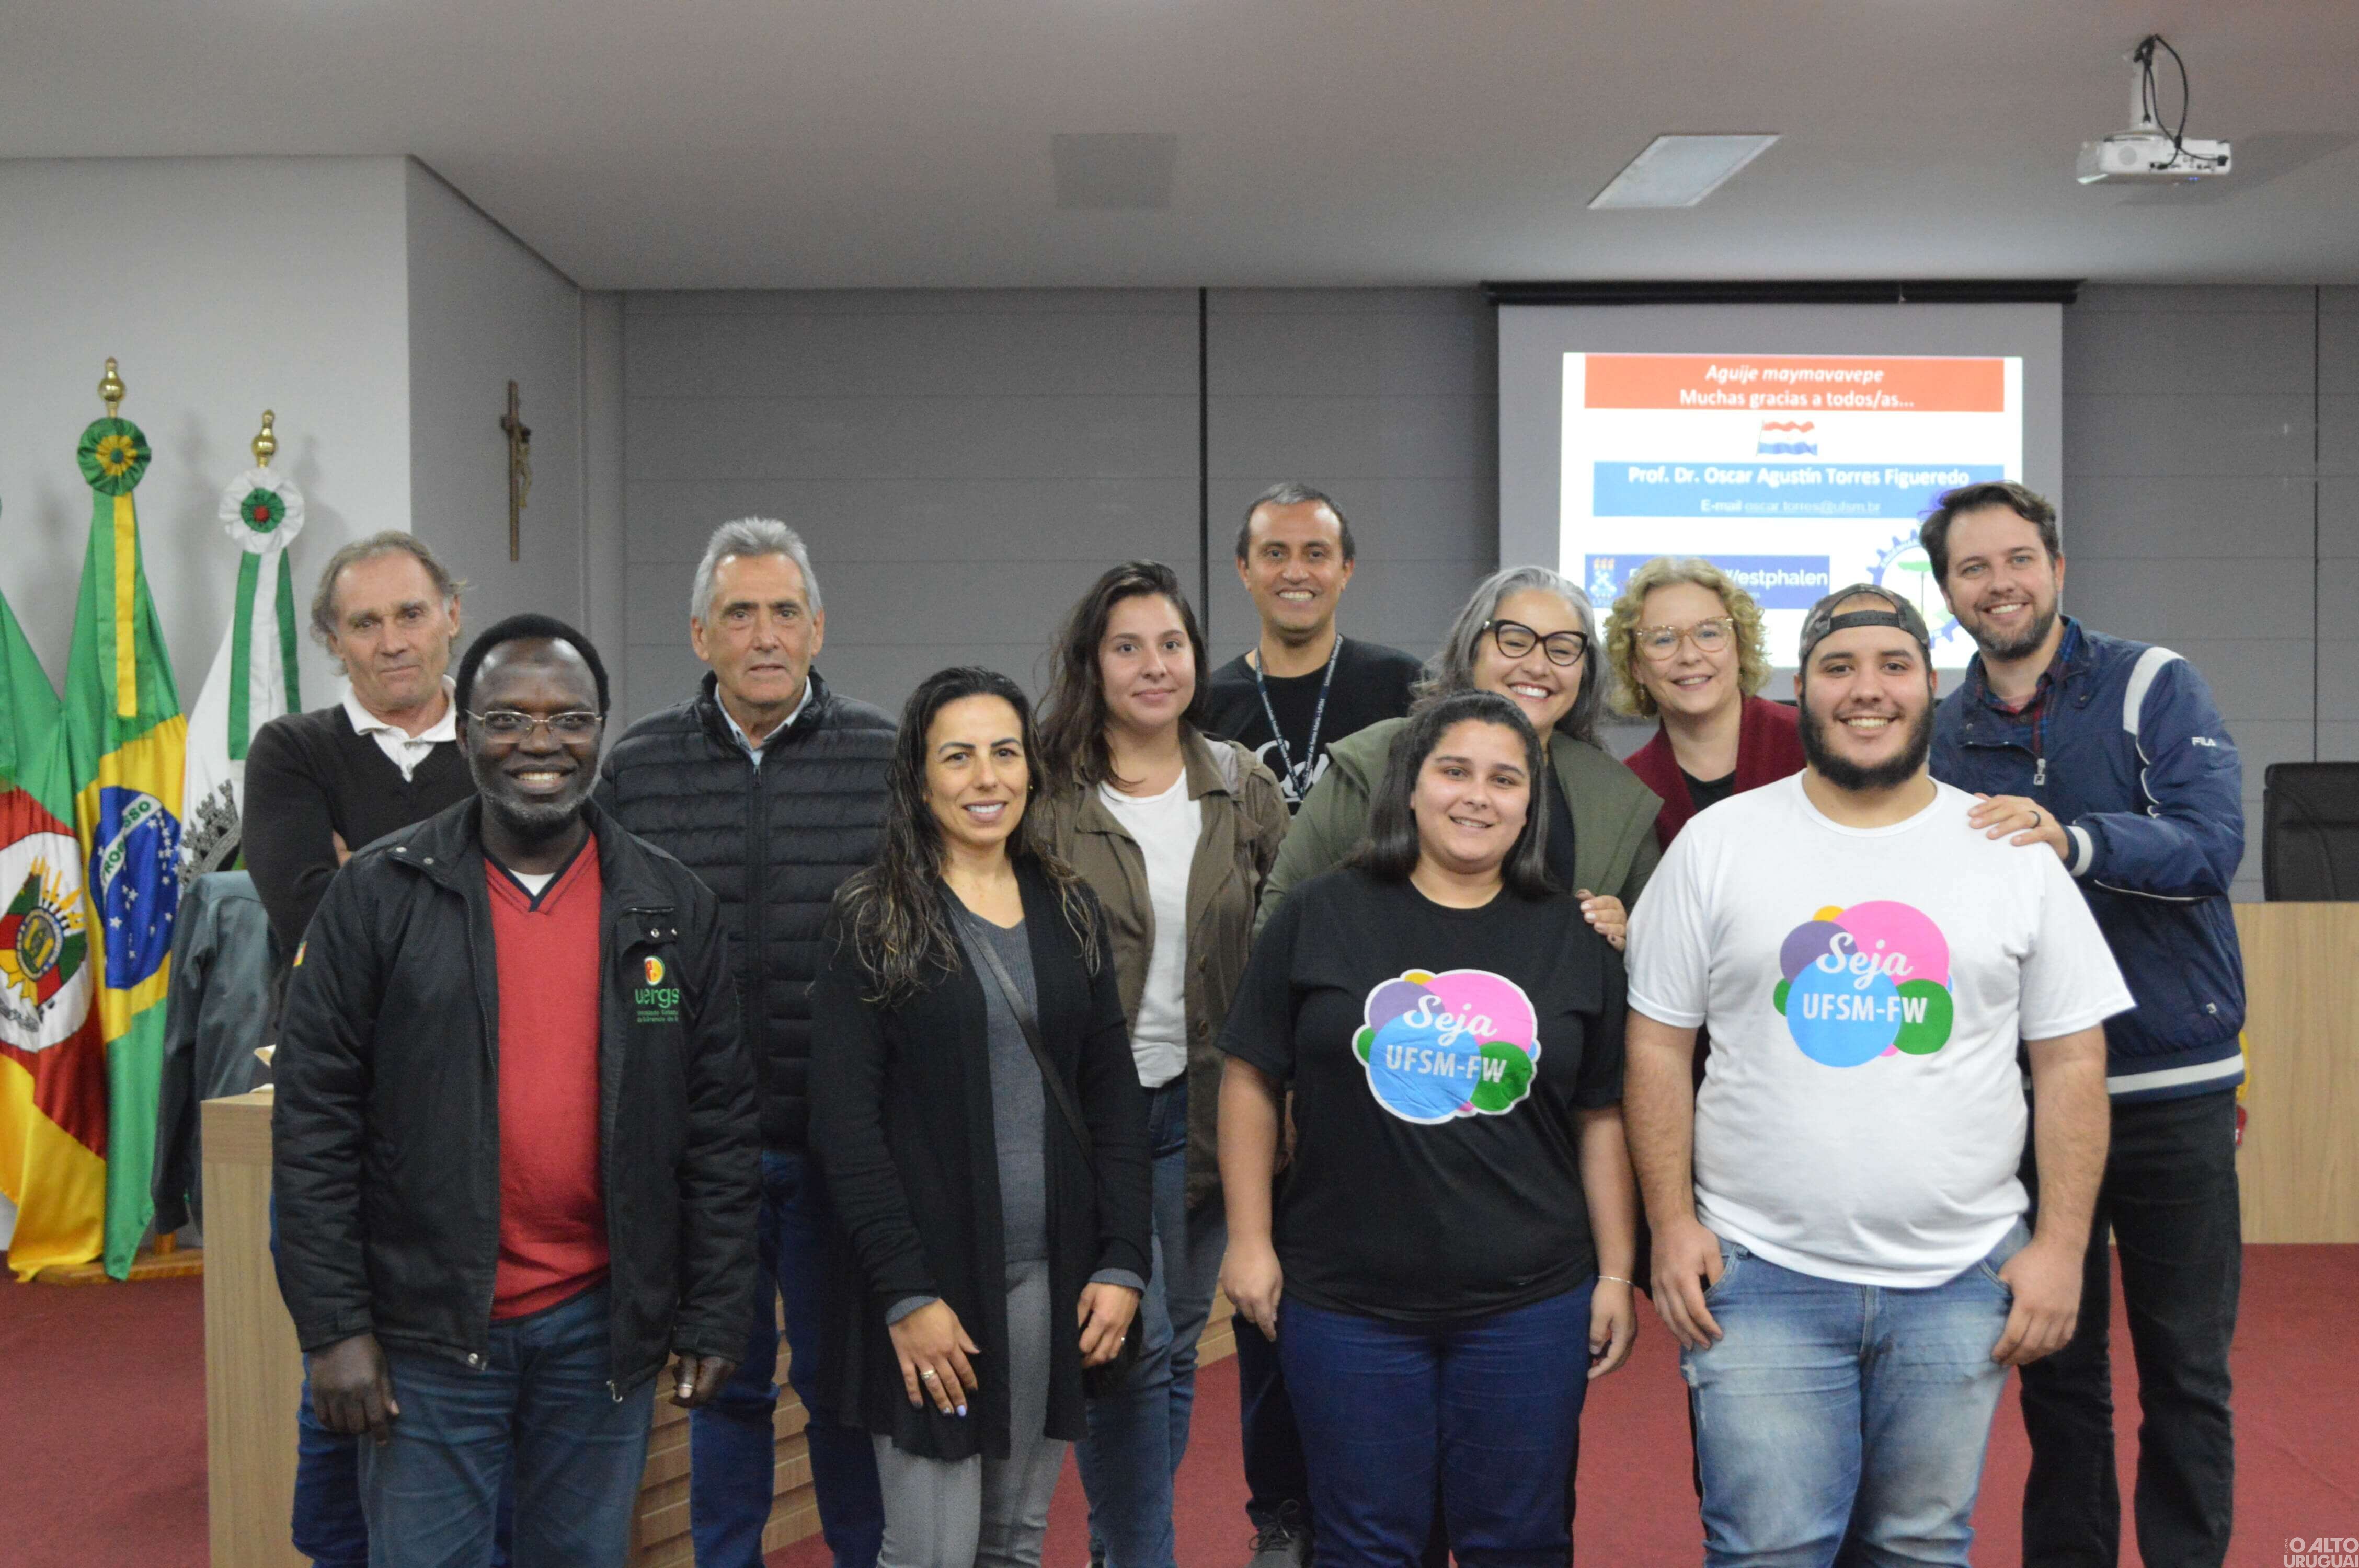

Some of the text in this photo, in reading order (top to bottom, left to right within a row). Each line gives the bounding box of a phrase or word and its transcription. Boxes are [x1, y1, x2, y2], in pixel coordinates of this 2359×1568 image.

[1705, 365, 1758, 385] Aguije
[1680, 389, 1915, 409] Muchas gracias a todos/as...
[1628, 466, 1670, 483] Prof.
[1674, 466, 1700, 484] Dr.
[1704, 467, 1753, 485] Oscar
[1825, 468, 1880, 486] Torres
[1885, 468, 1970, 489] Figueredo
[1700, 499, 1743, 512] E-mail
[2191, 736, 2217, 747] FILA
[1816, 931, 1914, 990] Seja
[634, 988, 680, 1009] uergs
[1803, 993, 1928, 1024] UFSM-FW
[1403, 994, 1497, 1047] Seja
[1385, 1044, 1507, 1083] UFSM-FW
